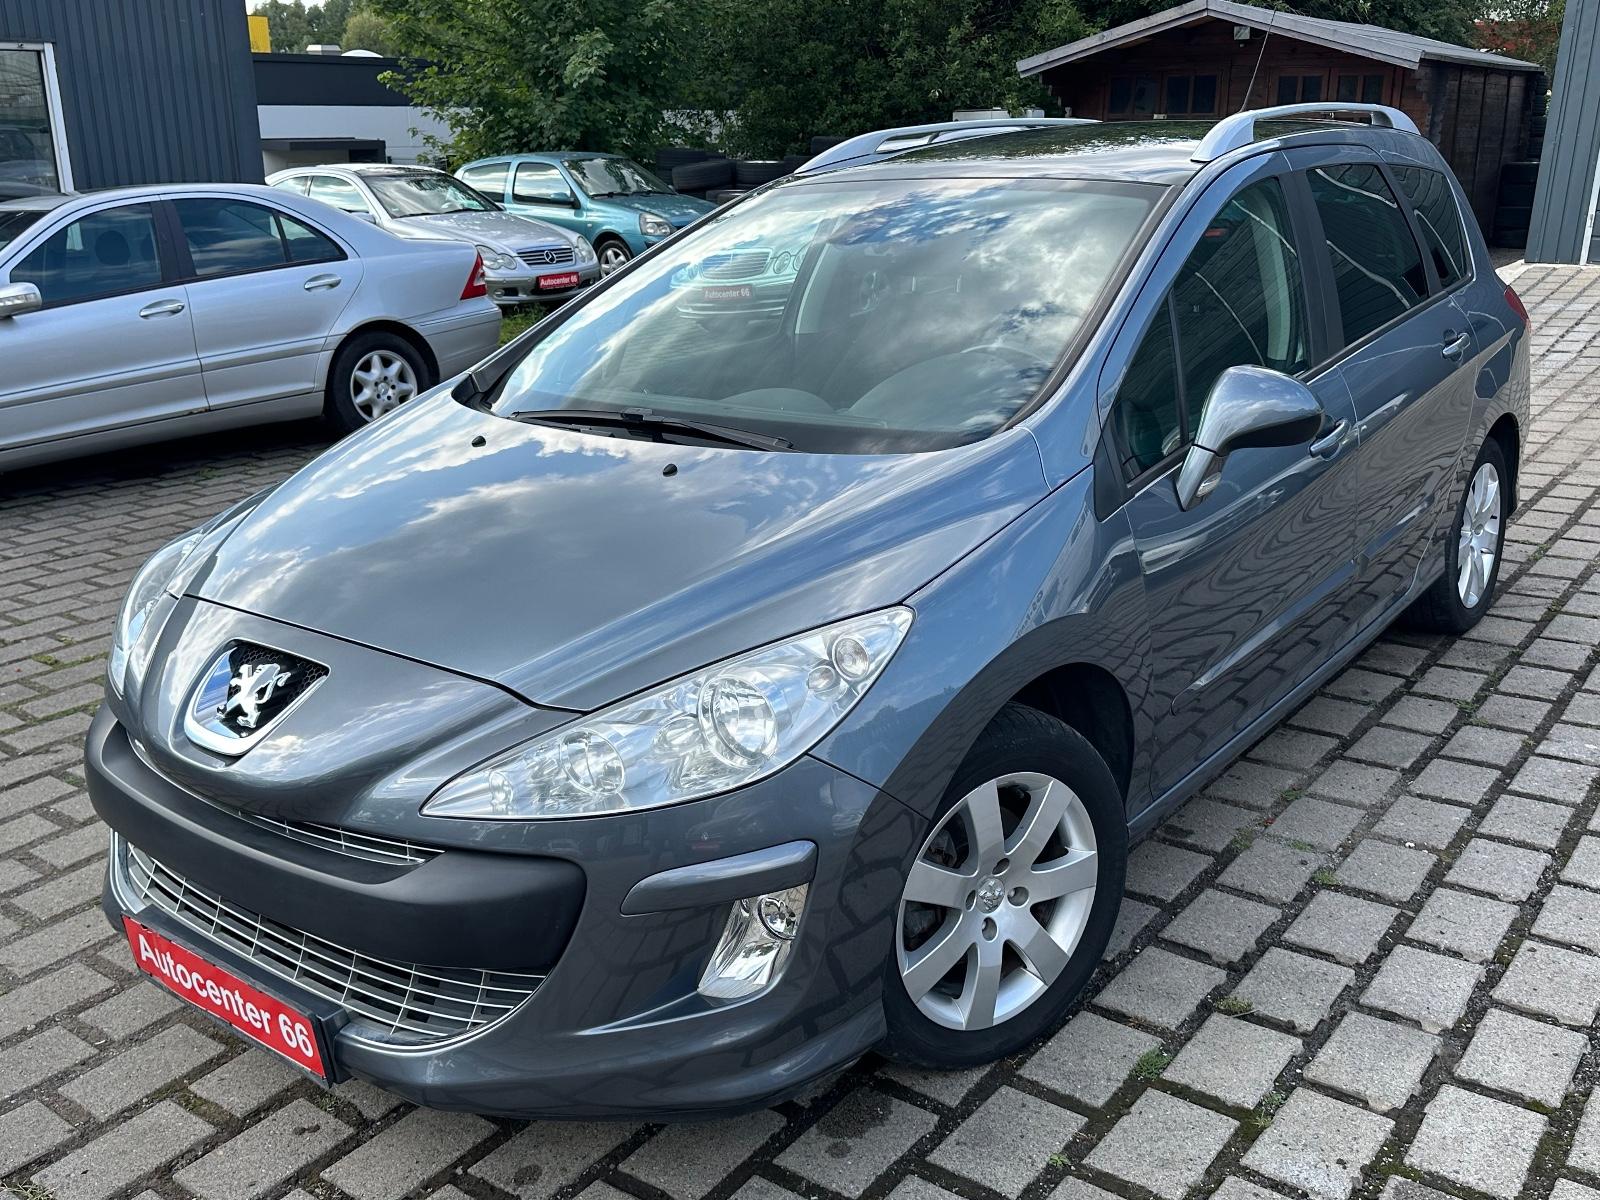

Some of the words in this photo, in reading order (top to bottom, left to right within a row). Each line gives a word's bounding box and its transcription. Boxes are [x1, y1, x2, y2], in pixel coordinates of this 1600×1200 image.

[540, 276, 570, 286] Autocenter
[570, 274, 578, 283] 66
[704, 289, 740, 298] Autocenter
[740, 287, 750, 297] 66
[138, 933, 272, 1035] Autocenter
[278, 1013, 314, 1058] 66
